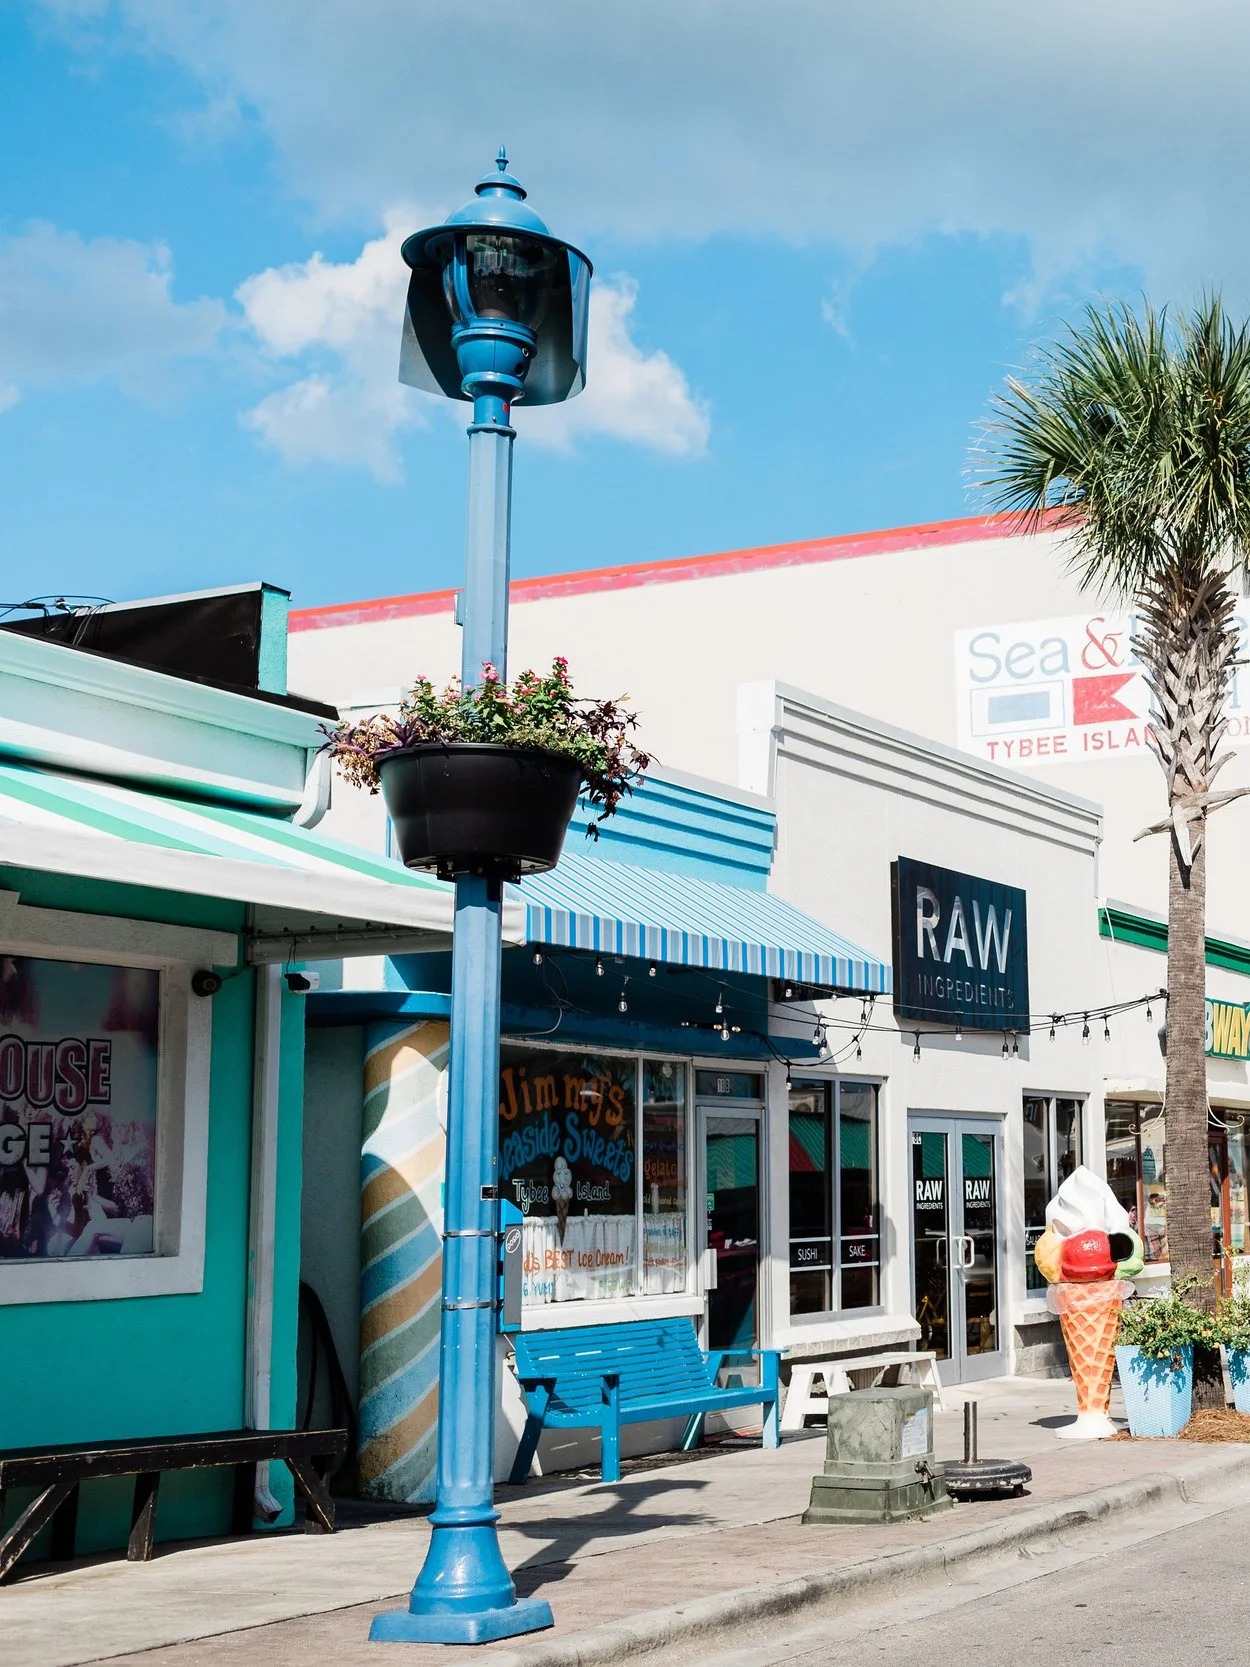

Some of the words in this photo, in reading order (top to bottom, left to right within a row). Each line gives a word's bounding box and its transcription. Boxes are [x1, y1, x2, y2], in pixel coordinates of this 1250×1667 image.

[968, 631, 1070, 683] Sea
[1080, 617, 1125, 670] &
[986, 735, 1068, 760] TYBEE
[1083, 725, 1158, 752] ISLAN
[916, 885, 1013, 974] RAW
[918, 973, 1015, 1010] INGREDIENTS
[499, 1066, 625, 1126] Jimmy's
[499, 1111, 560, 1181] easide
[564, 1111, 635, 1183] Sweets
[512, 1178, 549, 1215] Tybee
[576, 1180, 612, 1201] Island
[916, 1180, 943, 1201] RAW
[965, 1180, 990, 1200] RAW
[916, 1202, 943, 1210] INGREDIENTS
[966, 1201, 991, 1209] INGREDIENTS
[544, 1249, 575, 1271] BEST
[797, 1248, 818, 1261] SUSHI
[848, 1245, 866, 1258] SAKE
